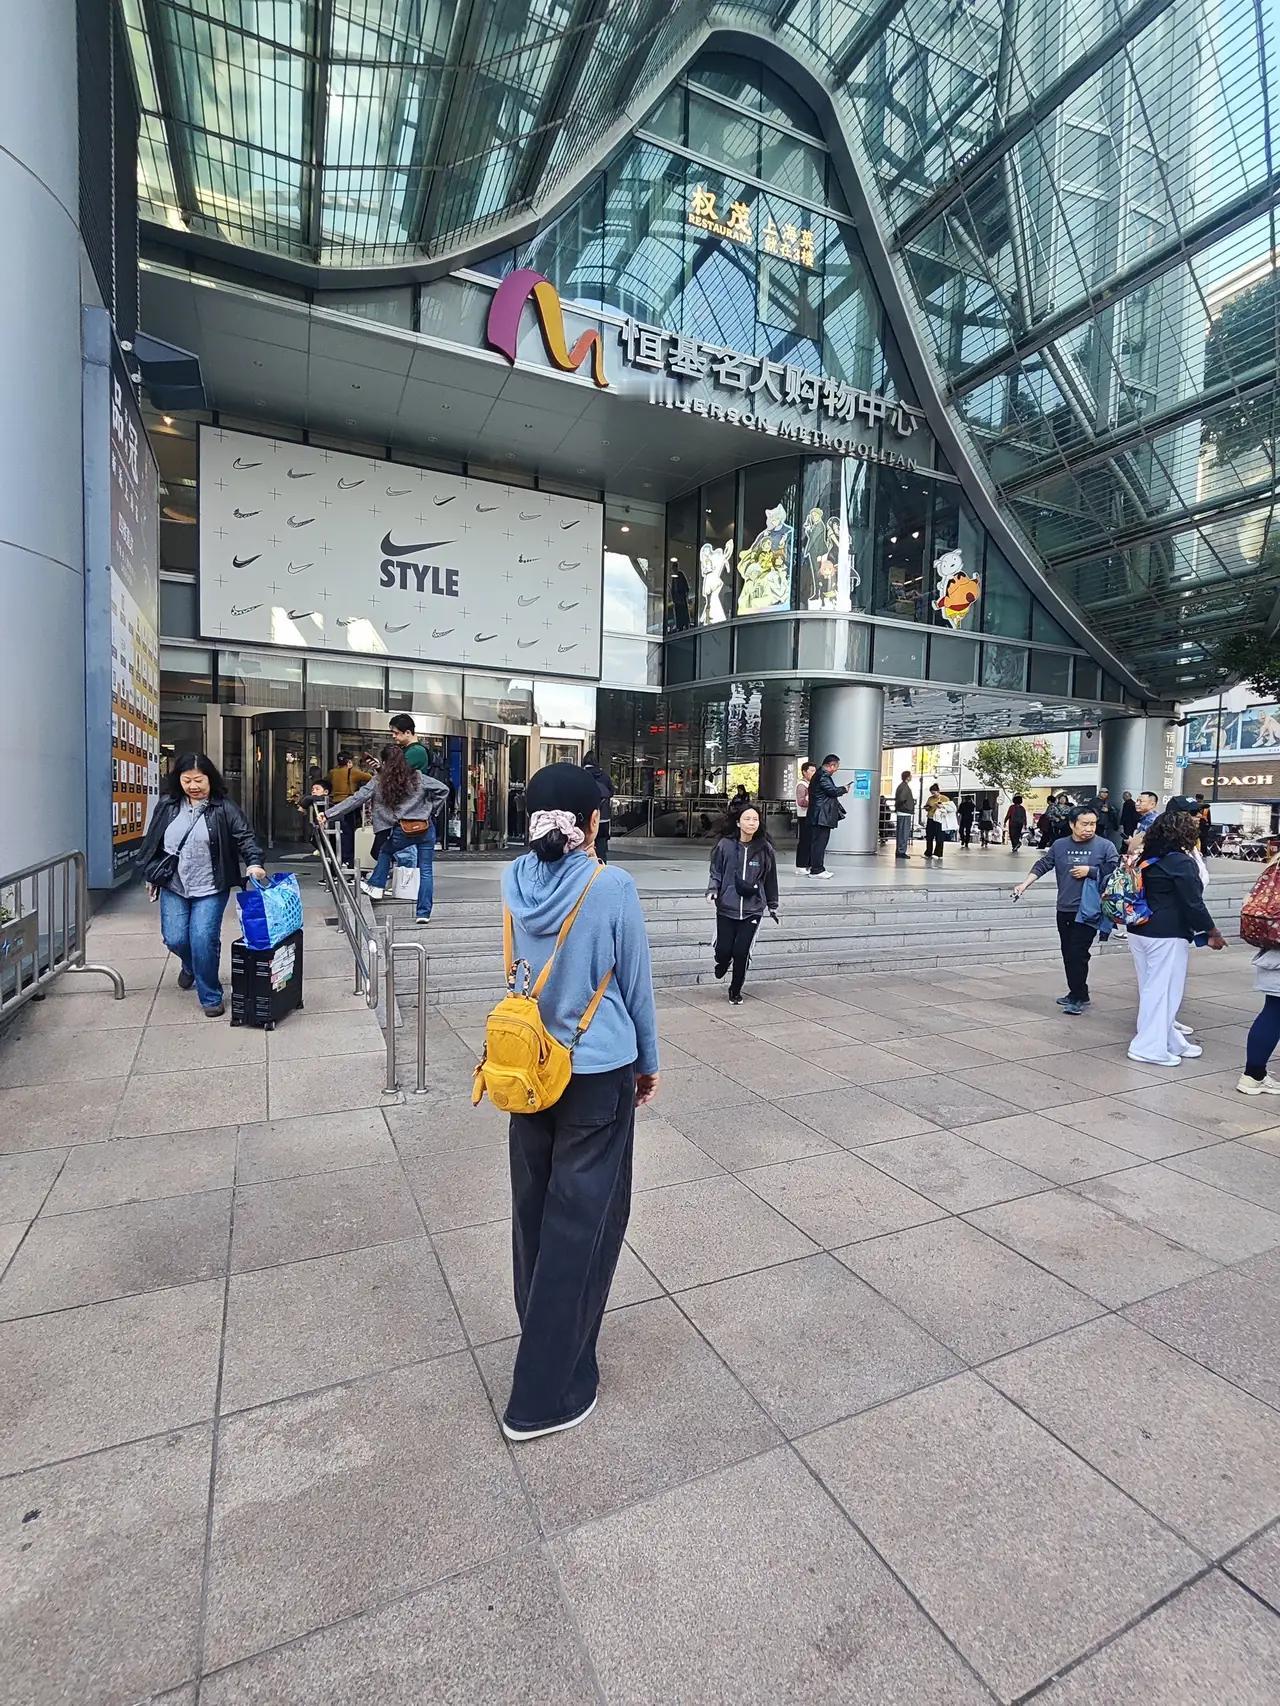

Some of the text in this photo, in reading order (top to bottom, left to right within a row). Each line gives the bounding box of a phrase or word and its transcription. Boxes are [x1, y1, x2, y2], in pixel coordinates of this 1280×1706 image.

[688, 213, 753, 246] RESTAURANT
[780, 419, 918, 470] METROPOLITAN
[380, 558, 459, 597] STYLE
[1200, 774, 1274, 787] COACH
